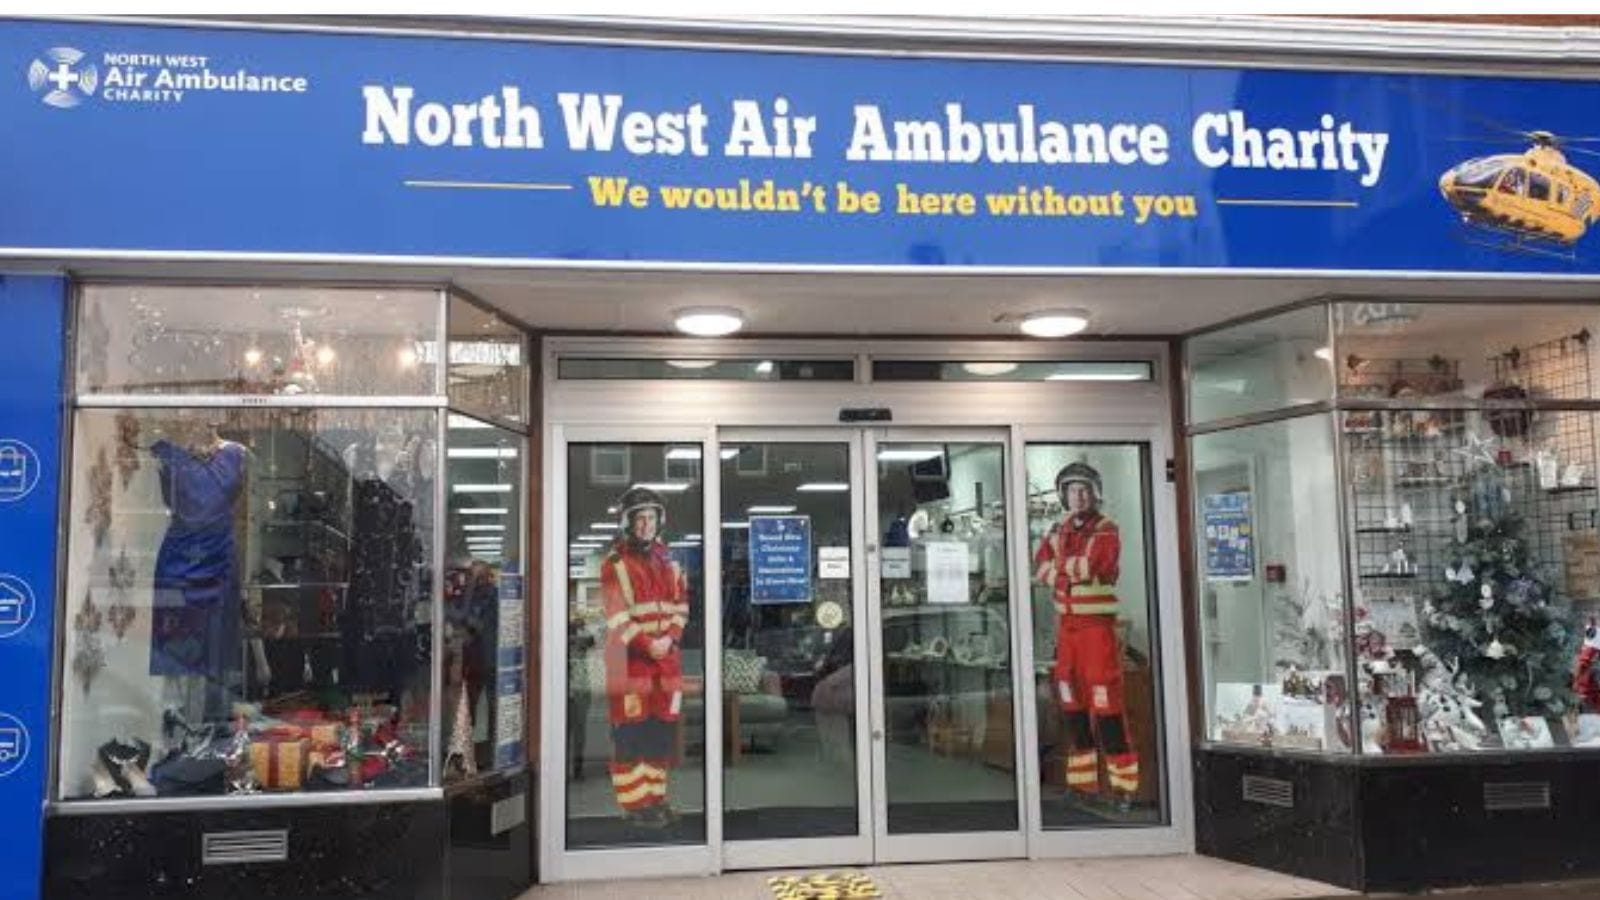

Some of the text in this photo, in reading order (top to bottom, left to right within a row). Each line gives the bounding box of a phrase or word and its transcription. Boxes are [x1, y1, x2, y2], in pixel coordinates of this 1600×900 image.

[103, 53, 208, 68] NORTH WEST
[103, 66, 308, 93] Air Ambulance
[103, 88, 184, 102] CHARITY
[362, 85, 1389, 187] North West Air Ambulance Charity
[587, 175, 650, 209] We
[836, 181, 881, 214] be
[896, 183, 977, 216] here
[985, 185, 1125, 217] without
[1132, 194, 1198, 224] you
